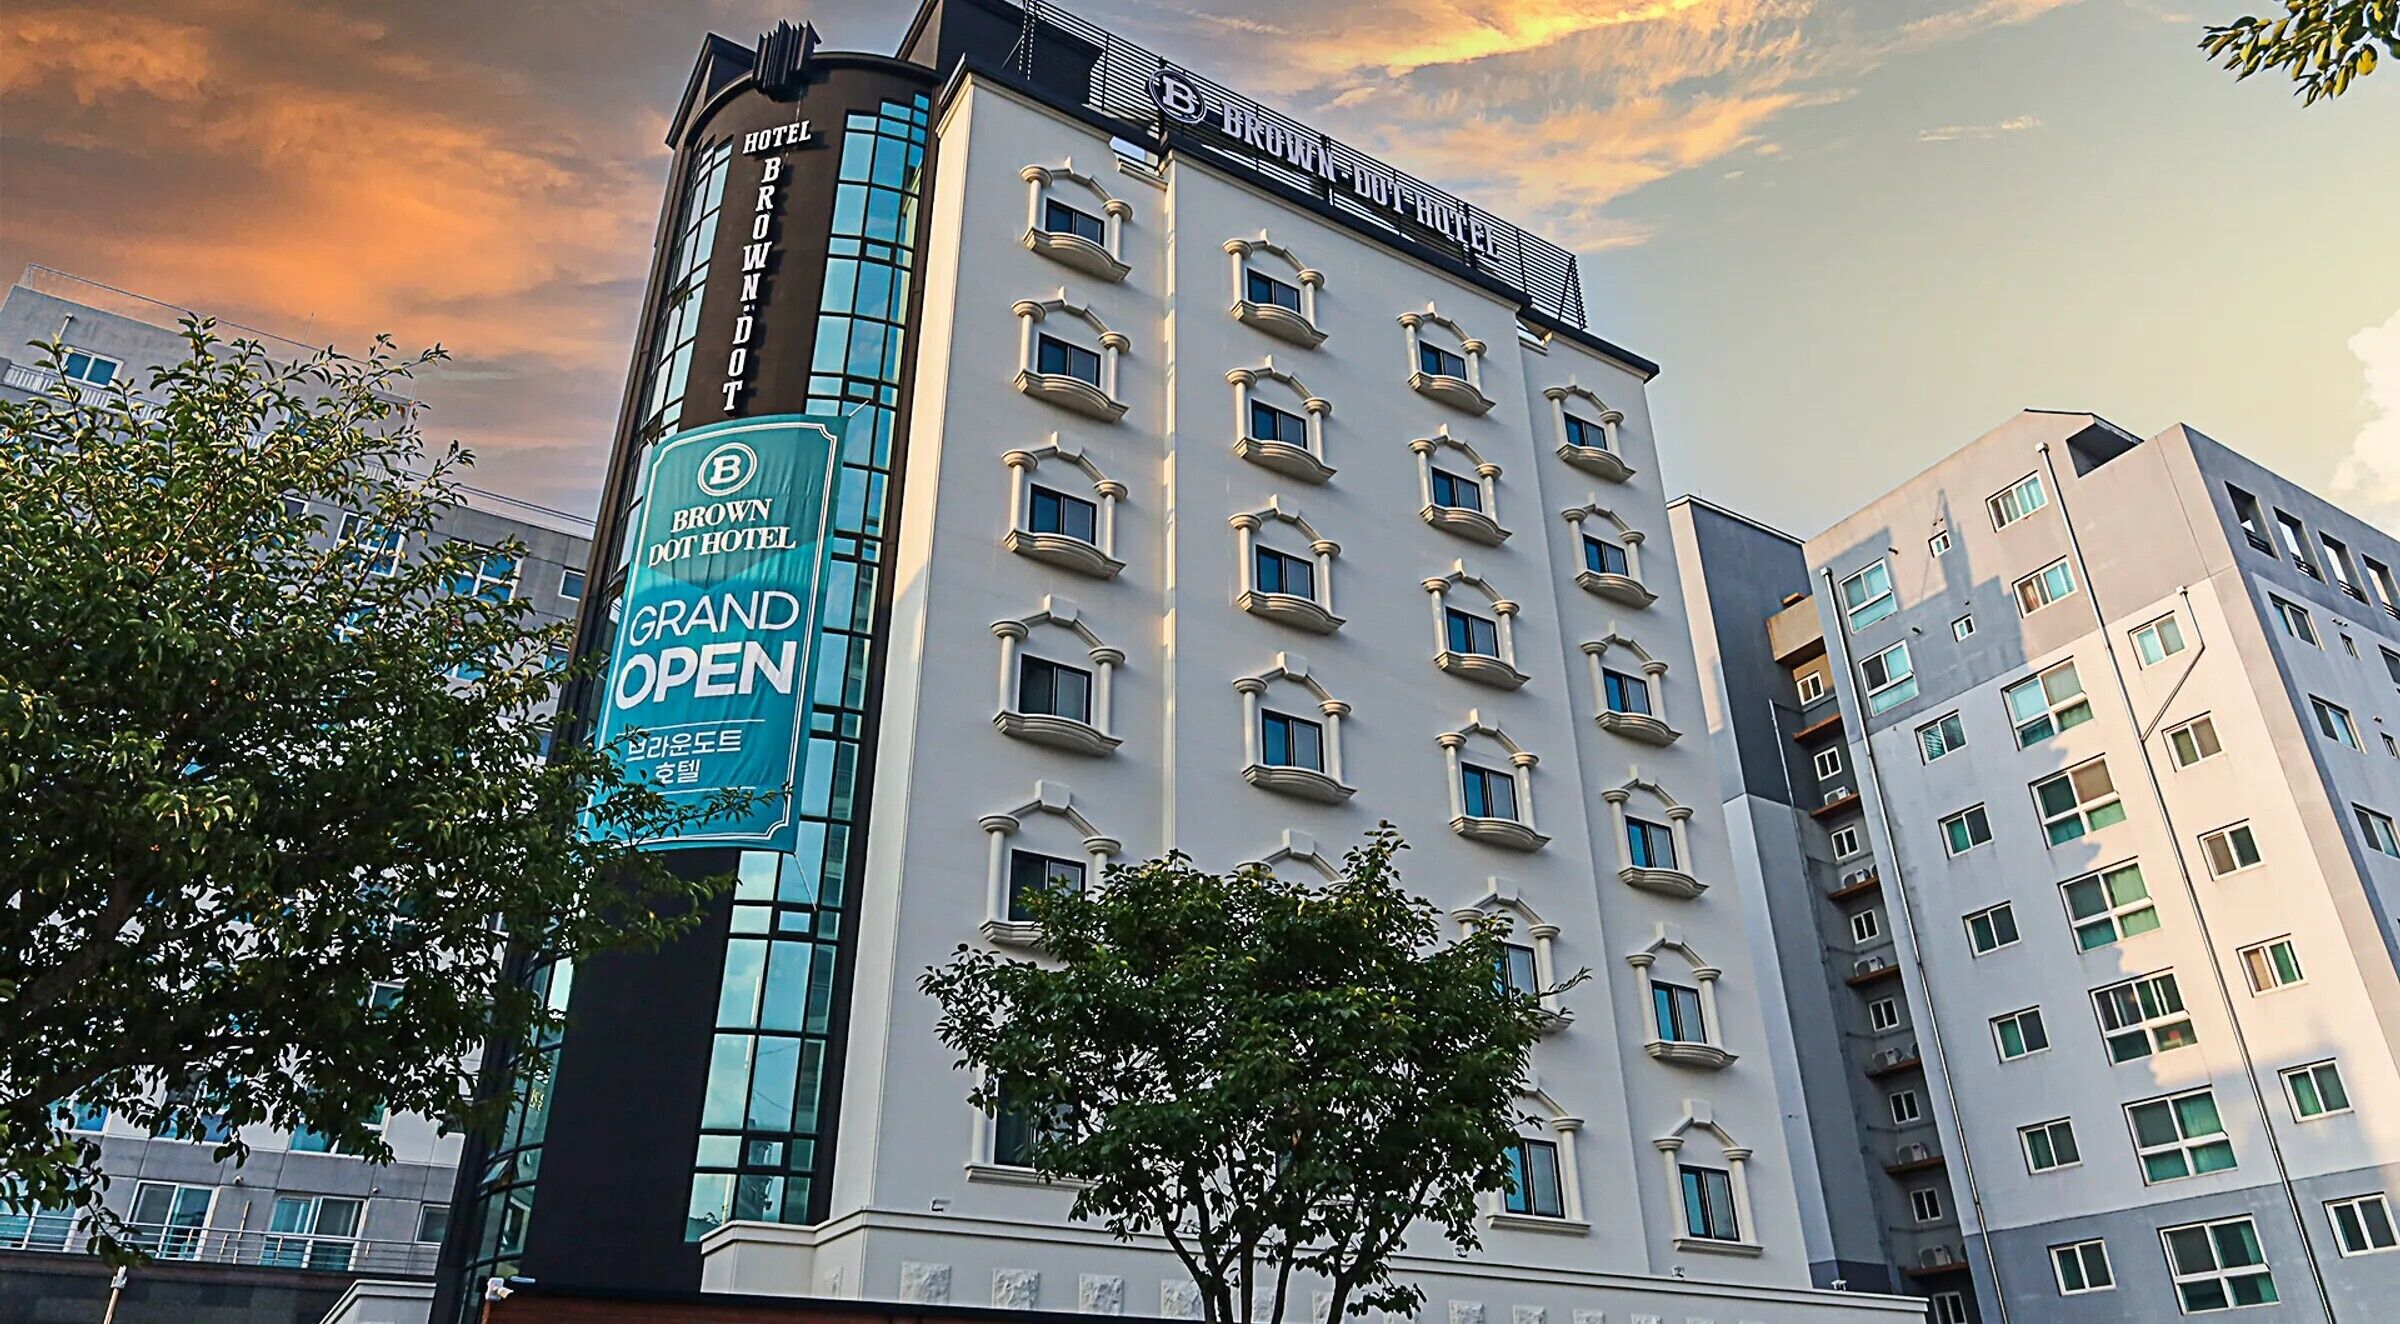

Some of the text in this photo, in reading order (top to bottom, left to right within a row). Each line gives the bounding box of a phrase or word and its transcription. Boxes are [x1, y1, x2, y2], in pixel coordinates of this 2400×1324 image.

[1162, 75, 1195, 114] B
[743, 120, 812, 155] HOTEL
[1414, 192, 1500, 259] HOTEL
[709, 454, 742, 486] B
[670, 498, 773, 533] BROWN
[648, 526, 797, 568] DOT HOTEL
[629, 590, 800, 648] GRAND
[615, 640, 798, 711] OPEN
[625, 729, 742, 762] 브라운도트
[655, 759, 701, 785] 호텔
